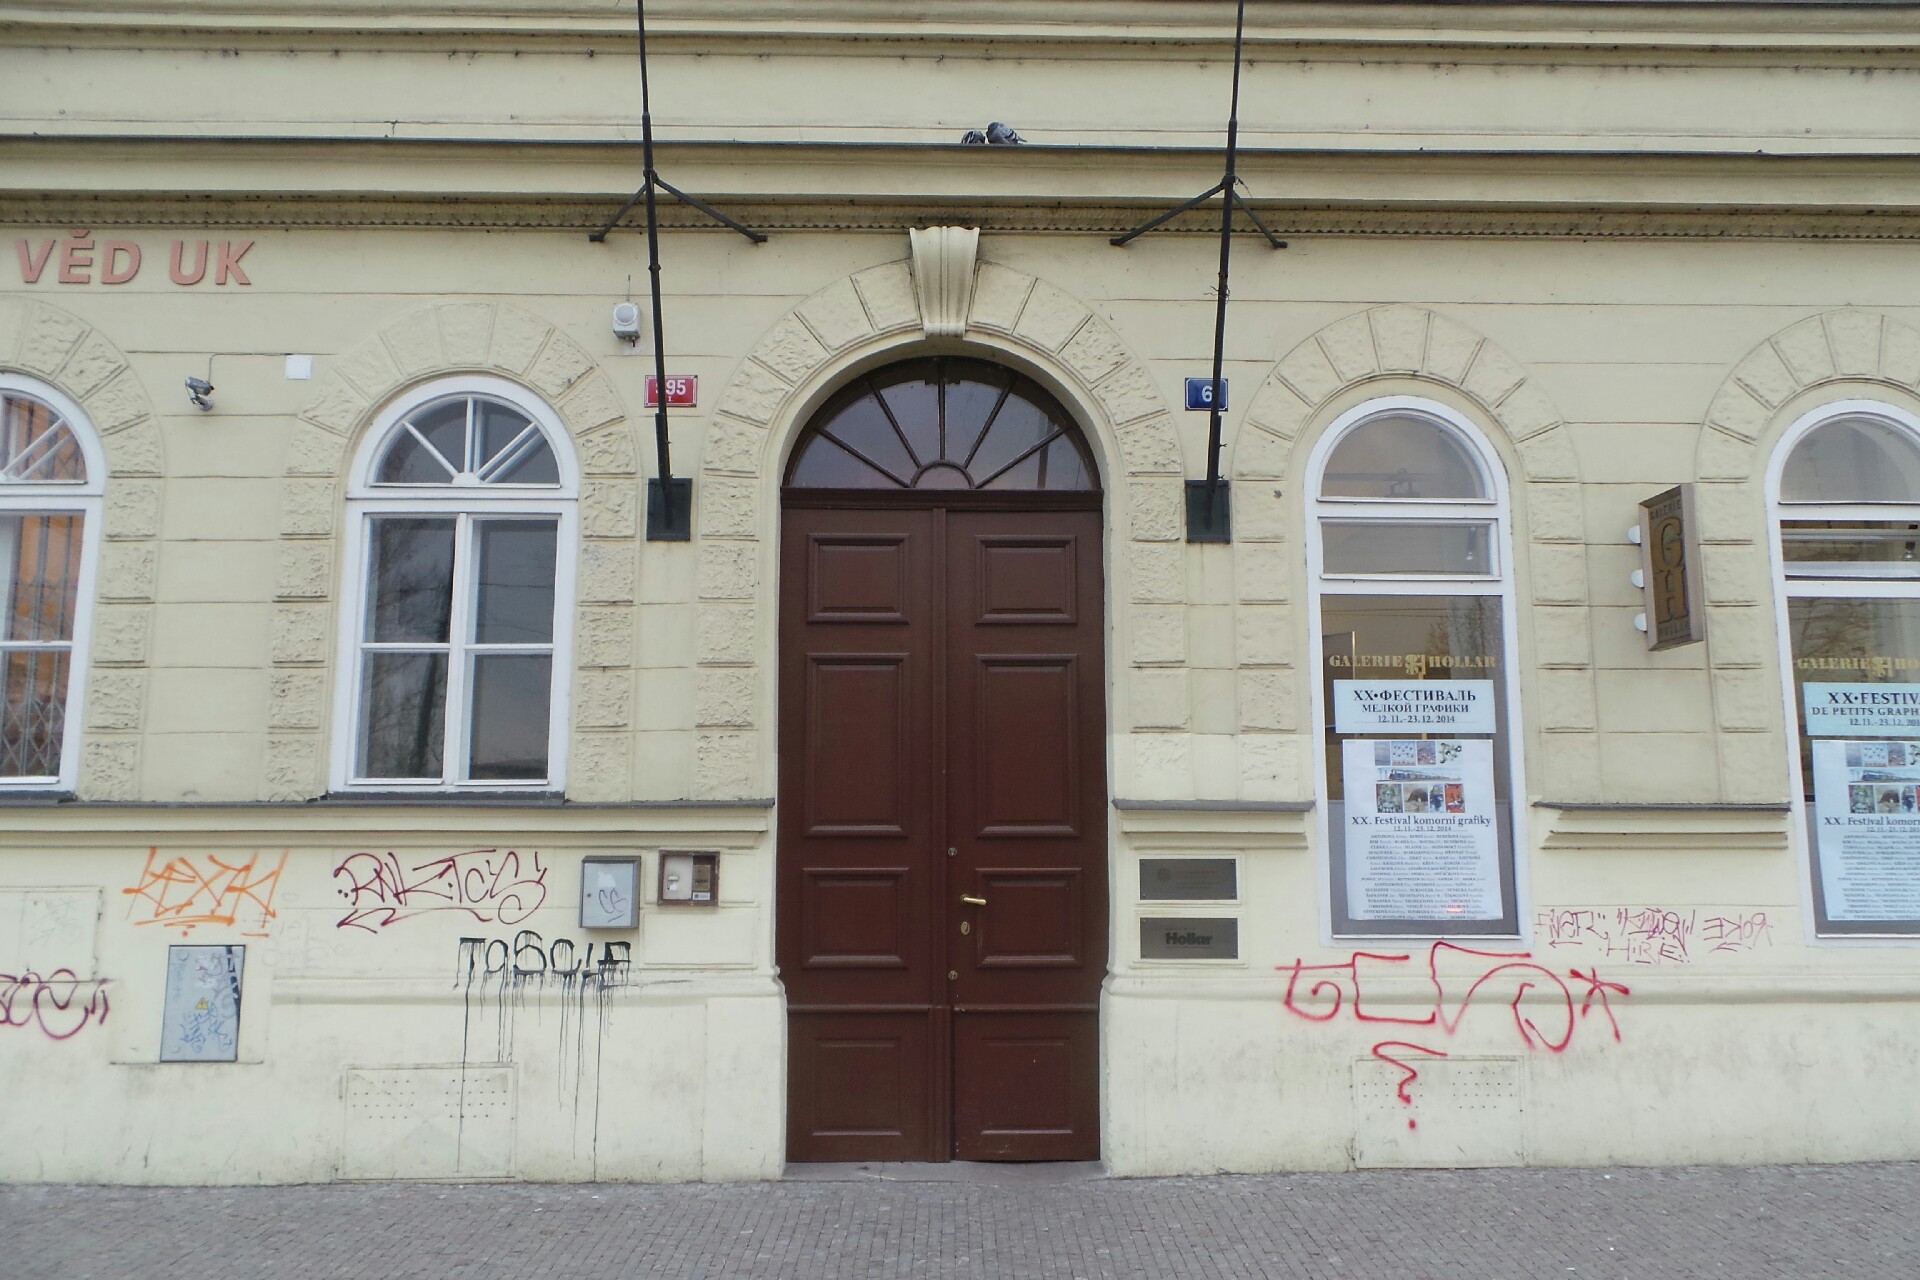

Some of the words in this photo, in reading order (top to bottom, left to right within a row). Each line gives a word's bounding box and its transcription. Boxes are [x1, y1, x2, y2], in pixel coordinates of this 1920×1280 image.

[15, 228, 142, 285] VĚD
[169, 240, 255, 286] UK
[656, 379, 686, 396] 95
[1201, 385, 1213, 402] 6
[1329, 655, 1403, 668] GALERIE
[1429, 655, 1497, 668] HOLLAR
[1362, 702, 1412, 713] МЕЛКОЙ
[1415, 704, 1469, 713] ГРАФИКИ
[1812, 707, 1828, 716] DE
[1833, 707, 1874, 716] PETITS
[1351, 816, 1372, 825] XX.
[1374, 815, 1411, 825] Festival
[1413, 815, 1456, 825] komorní
[1458, 814, 1491, 827] grafiky
[1848, 816, 1884, 826] Festival
[1165, 932, 1213, 946] Hollar
